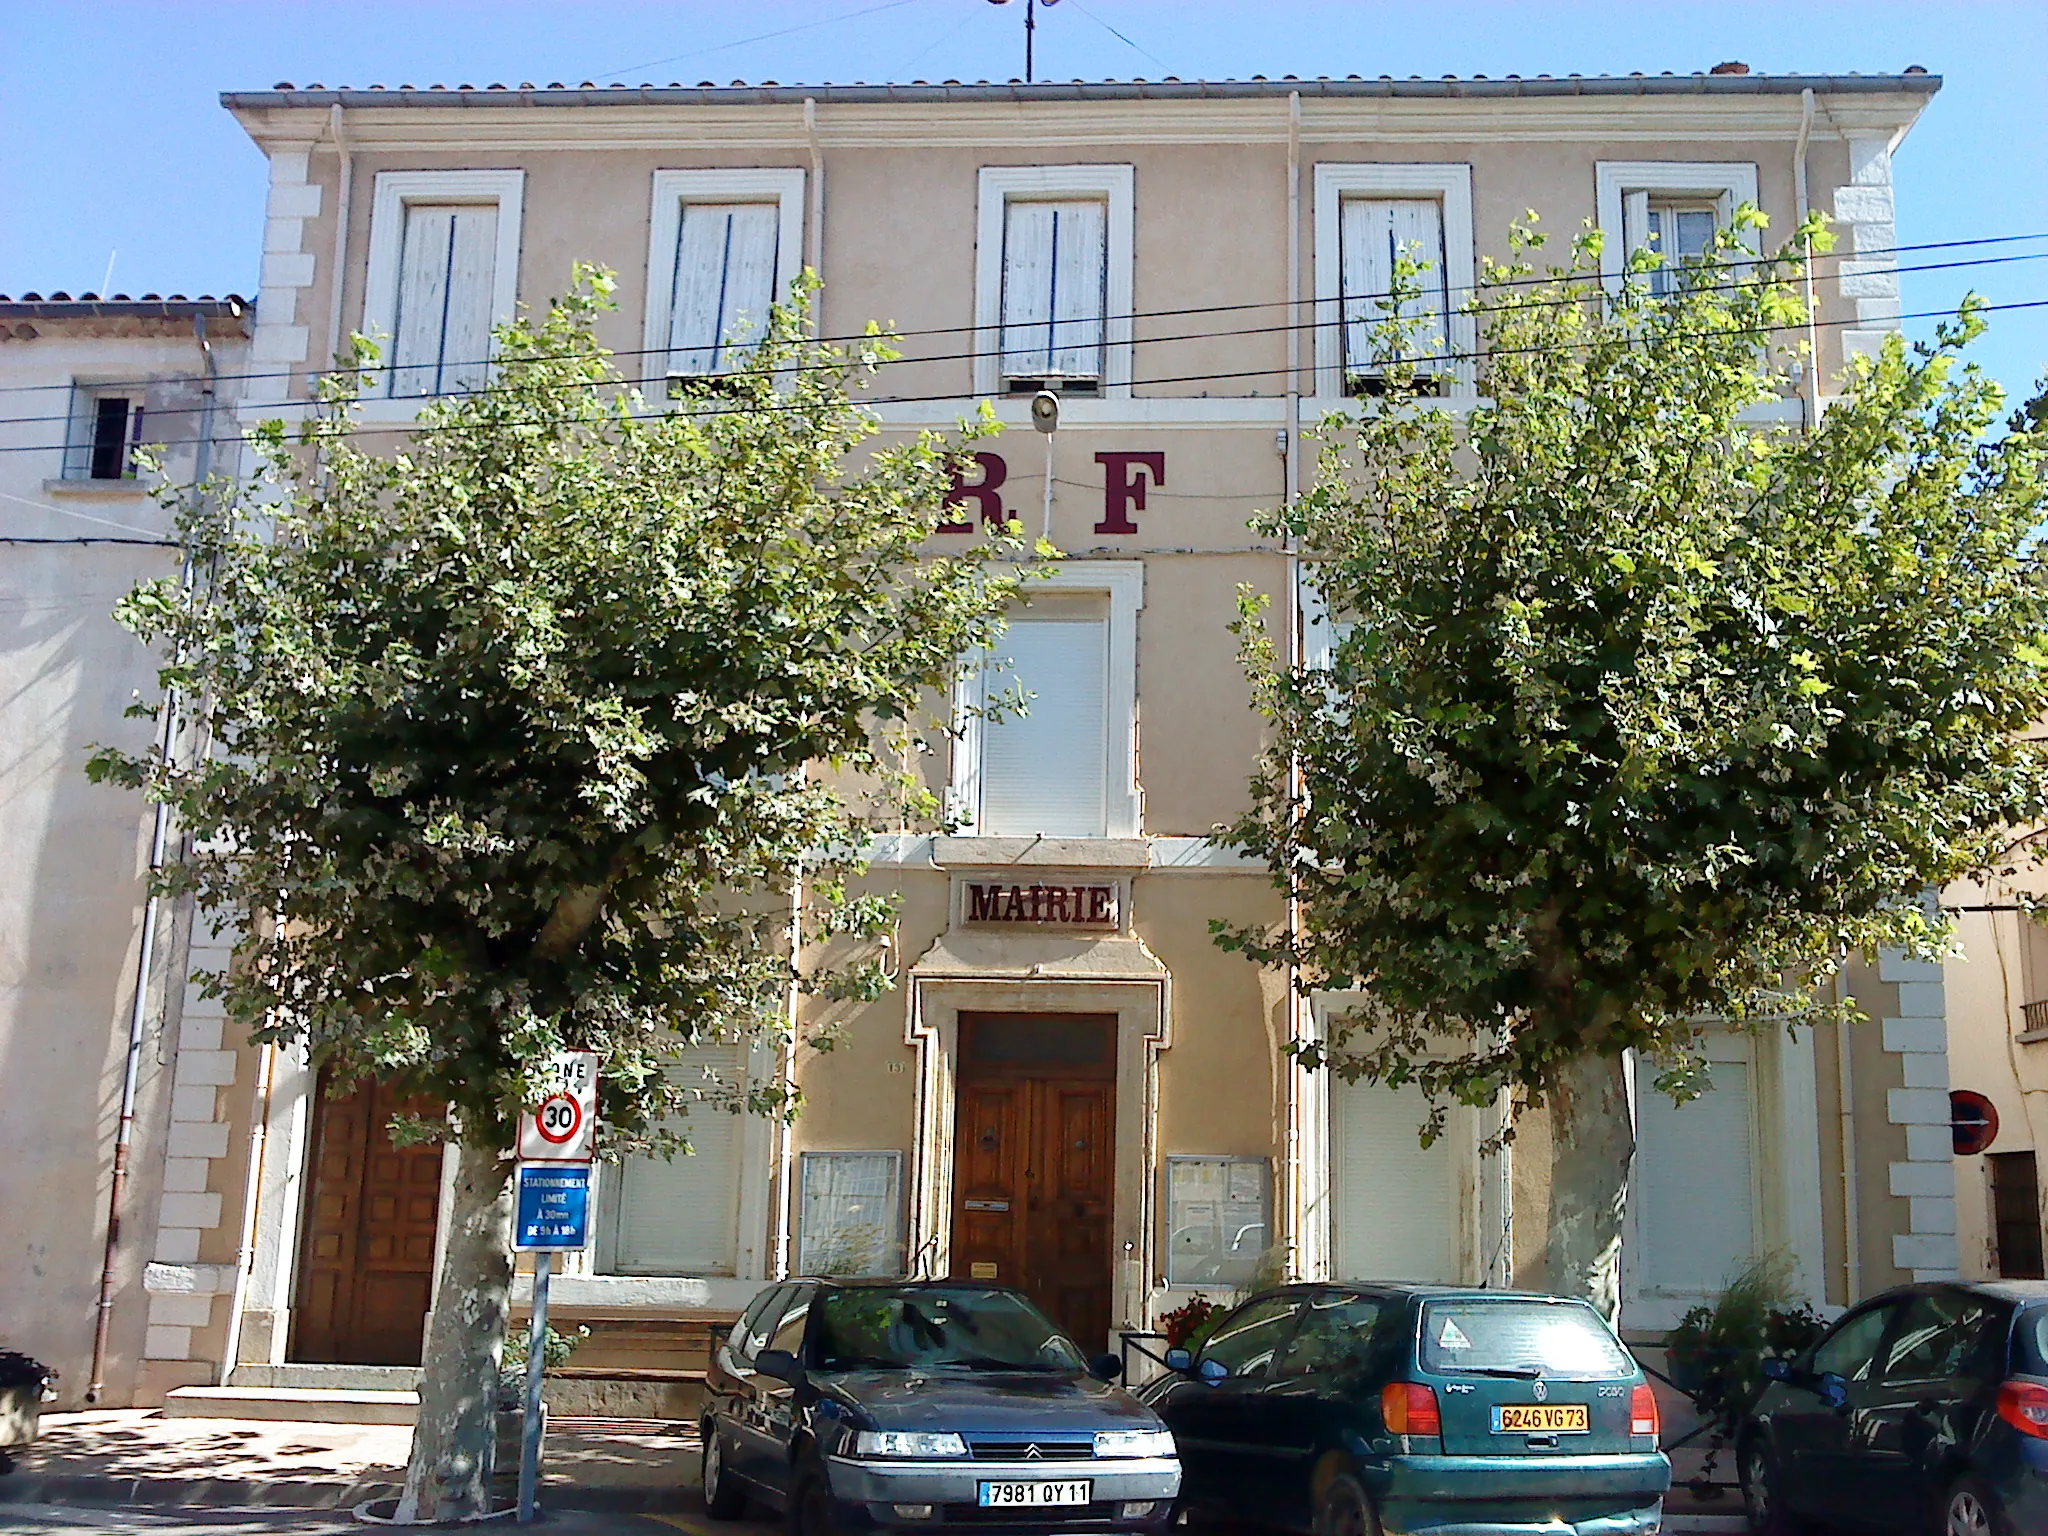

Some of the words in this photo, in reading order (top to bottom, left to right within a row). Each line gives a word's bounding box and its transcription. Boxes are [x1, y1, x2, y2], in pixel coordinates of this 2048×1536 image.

[935, 451, 1017, 534] R
[1094, 451, 1165, 534] F
[968, 884, 1112, 923] MAIRIE
[541, 1062, 585, 1079] ONE
[545, 1106, 572, 1128] 30
[523, 1177, 586, 1189] STATIONNEMENT
[541, 1192, 567, 1204] LIMITÉ
[527, 1224, 538, 1236] DE
[1502, 1409, 1541, 1428] 6246
[1544, 1409, 1564, 1428] VG
[1566, 1409, 1585, 1428] 73
[991, 1484, 1034, 1503] 7981
[1043, 1484, 1064, 1503] QY
[1069, 1483, 1087, 1501] 11
